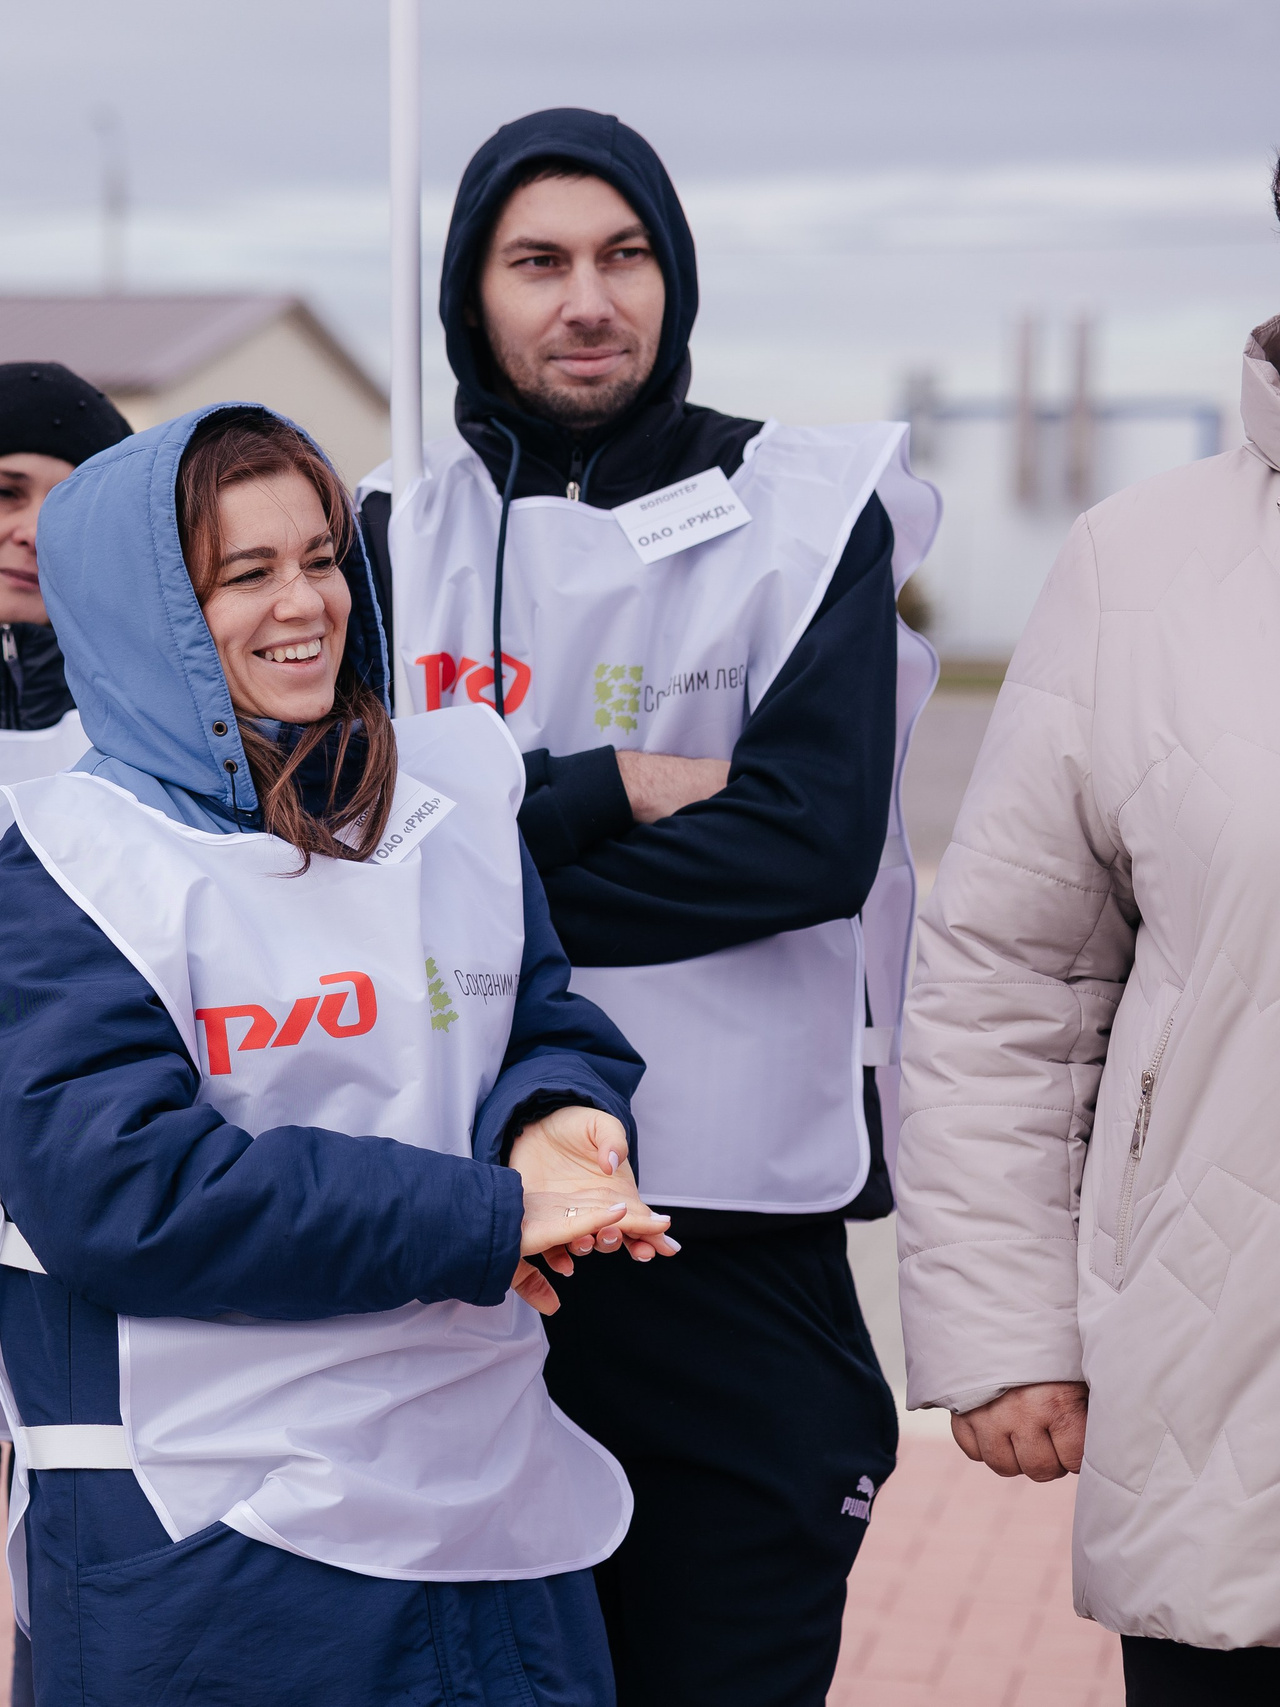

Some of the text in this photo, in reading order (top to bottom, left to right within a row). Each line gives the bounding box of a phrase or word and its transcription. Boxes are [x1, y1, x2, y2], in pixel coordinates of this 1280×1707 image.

[638, 504, 736, 547] ОАО «РЖД»
[715, 664, 745, 690] лес
[375, 833, 404, 860] ОАО
[403, 797, 441, 834] «РЖД»
[454, 969, 514, 1005] Сохраним
